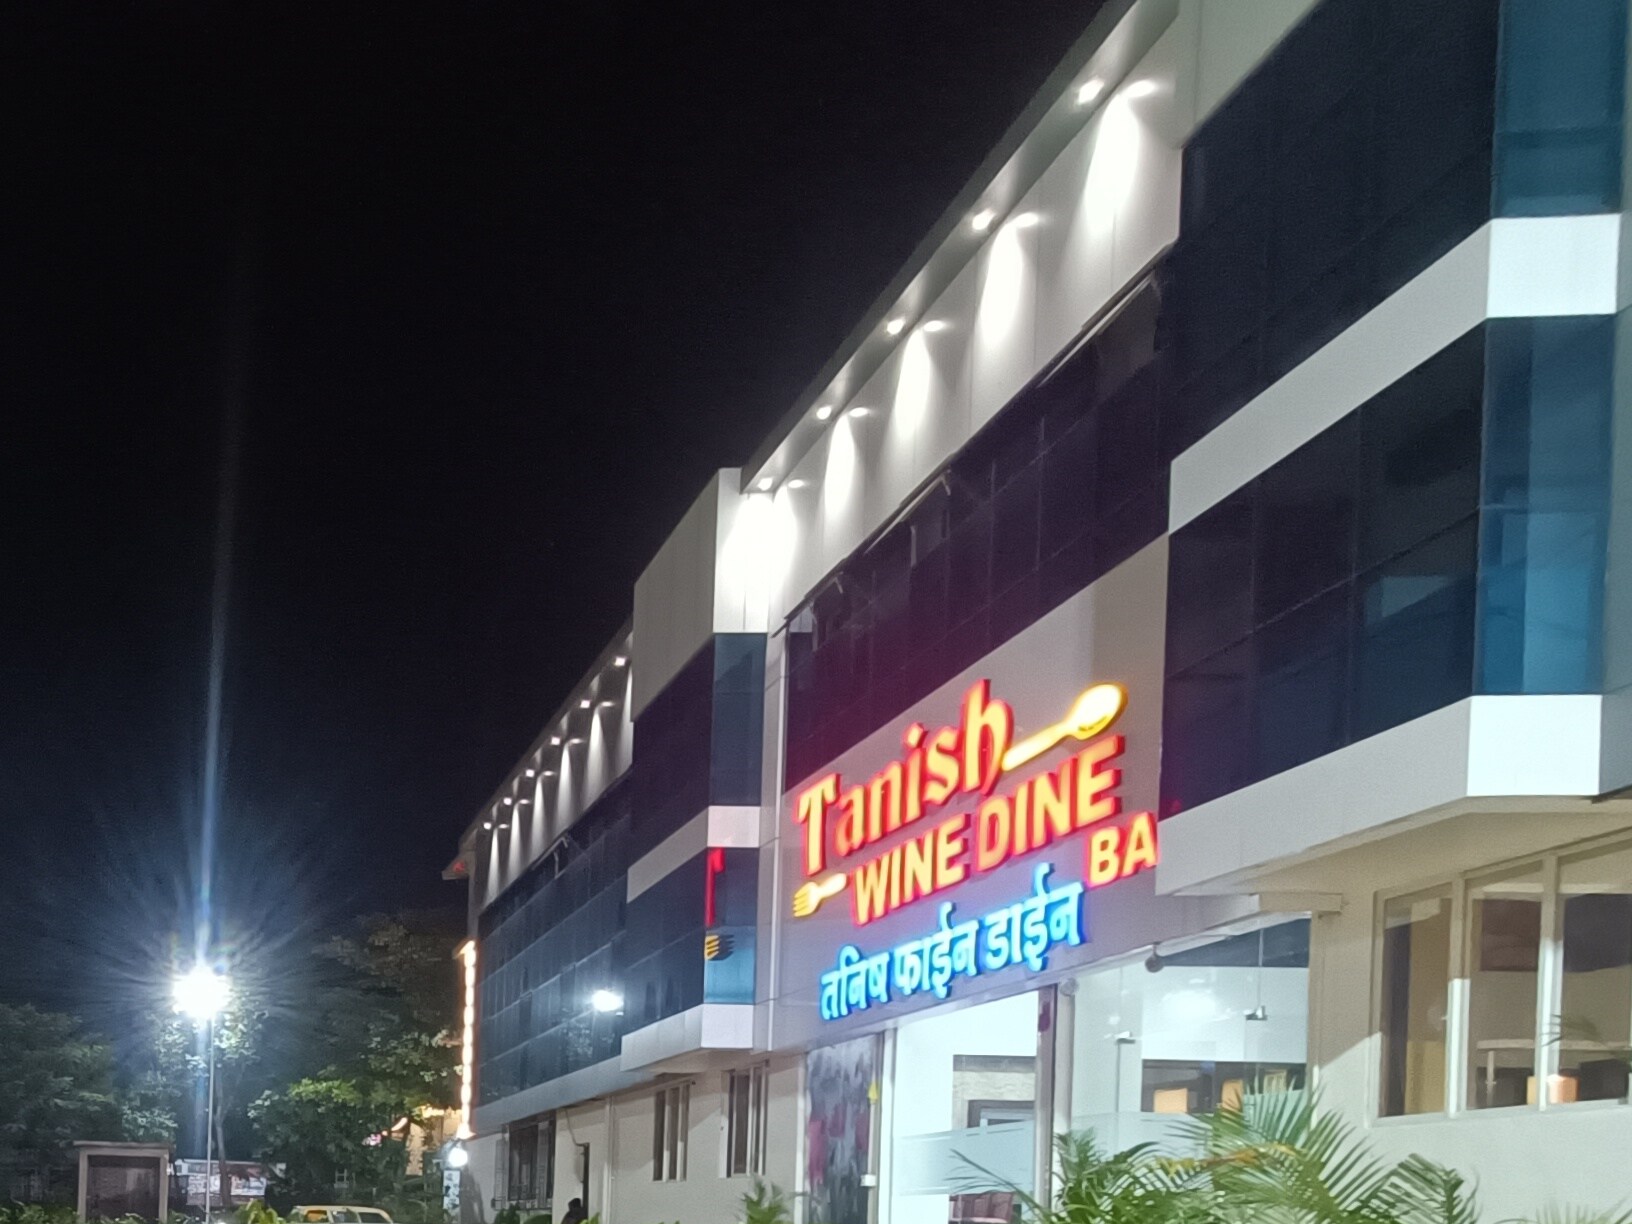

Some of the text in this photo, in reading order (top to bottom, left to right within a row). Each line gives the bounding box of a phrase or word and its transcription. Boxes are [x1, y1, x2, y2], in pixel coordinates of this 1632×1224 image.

[797, 678, 1014, 876] Tanish
[851, 734, 1125, 926] WINE DINE
[1087, 811, 1158, 889] BA
